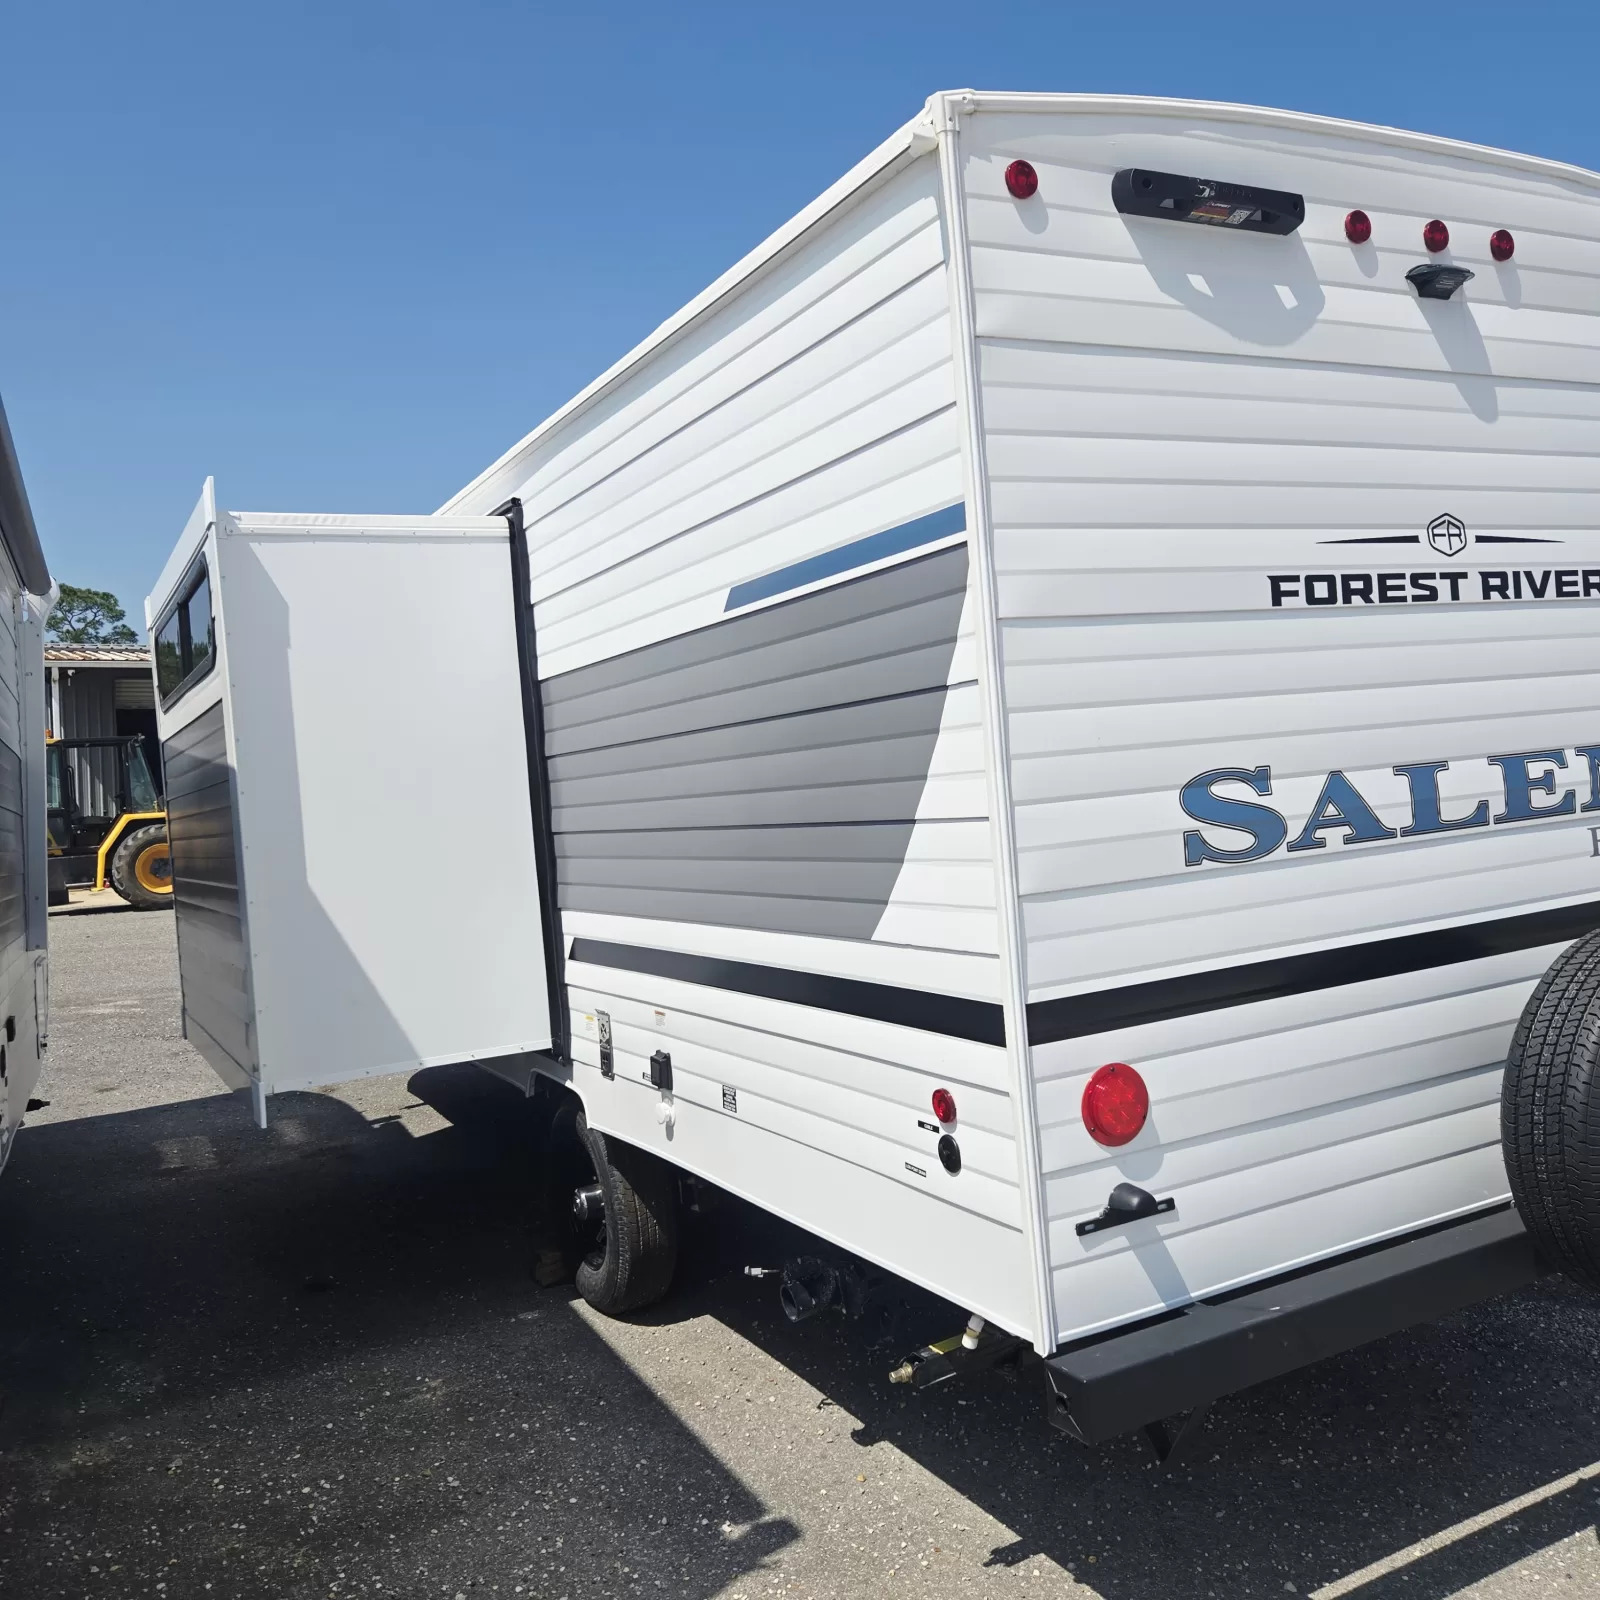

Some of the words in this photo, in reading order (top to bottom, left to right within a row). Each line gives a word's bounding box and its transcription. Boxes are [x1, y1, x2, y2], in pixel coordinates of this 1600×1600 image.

[1266, 571, 1469, 607] FOREST
[1478, 569, 1600, 600] RIVER
[1179, 744, 1600, 867] SALE
